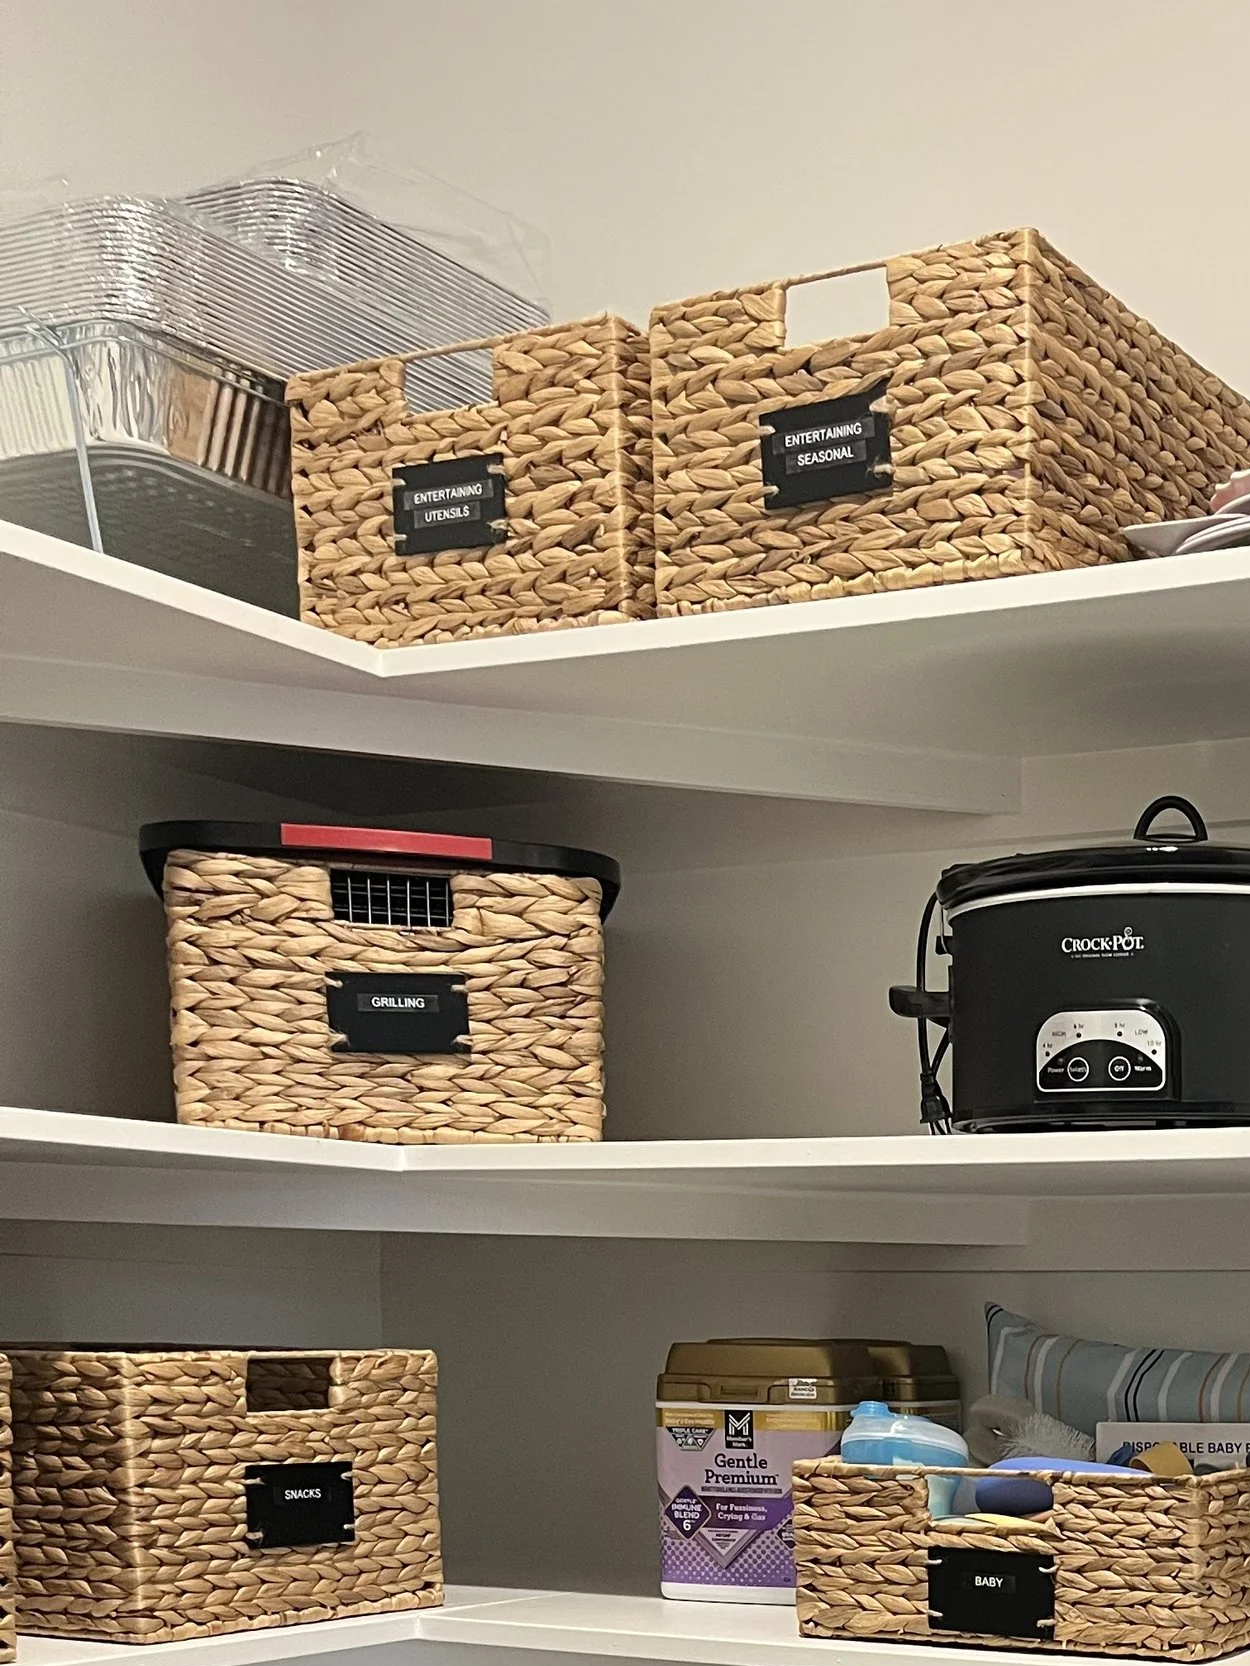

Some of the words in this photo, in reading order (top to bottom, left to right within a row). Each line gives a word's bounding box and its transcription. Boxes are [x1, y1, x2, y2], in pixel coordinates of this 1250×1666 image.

[784, 422, 862, 448] ENTERTAINING
[797, 446, 855, 467] SEASONAL
[414, 483, 483, 505] ENTERTAINING
[424, 505, 470, 523] UTENSILS
[371, 996, 425, 1009] GRILLING
[1134, 1028, 1149, 1036] LOW
[1207, 1441, 1242, 1454] BABY
[714, 1453, 768, 1470] Gentle
[284, 1488, 322, 1500] SNACKS
[671, 1503, 702, 1512] IMMUNE
[715, 1502, 729, 1510] For
[674, 1511, 700, 1519] BLEND
[717, 1511, 743, 1522] Crying
[743, 1512, 750, 1520] &
[751, 1512, 766, 1520] Gas
[974, 1575, 1004, 1588] BABY
